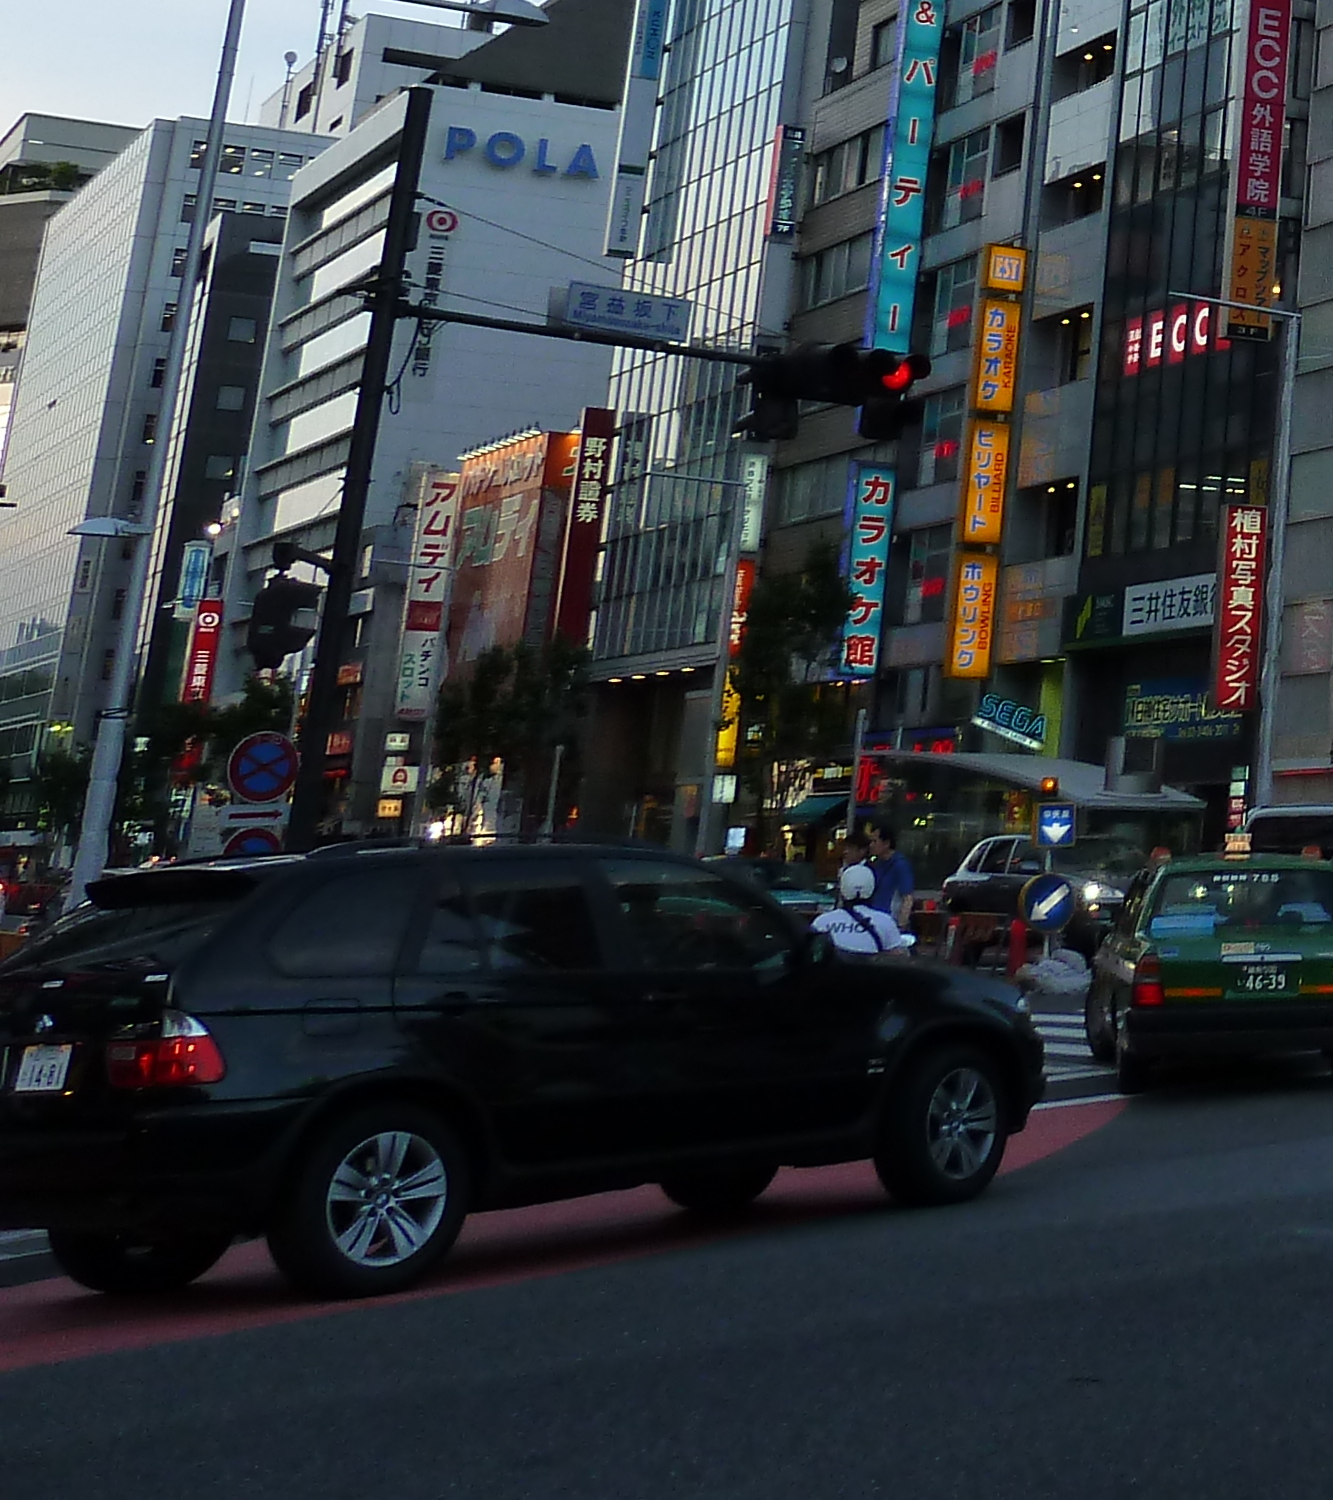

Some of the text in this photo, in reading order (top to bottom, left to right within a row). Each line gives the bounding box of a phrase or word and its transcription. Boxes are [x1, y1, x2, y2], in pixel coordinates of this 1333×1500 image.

[444, 126, 599, 179] POLA
[580, 291, 681, 322] 宮益坂下
[1150, 307, 1210, 360] ECC
[980, 307, 1008, 403] カラオケ
[1002, 325, 1016, 389] KARAOKE
[576, 437, 607, 524] 野村證券
[989, 451, 1004, 514] BILLIARD
[845, 475, 891, 668] カラオケ館
[957, 562, 983, 669] ボウリング
[977, 582, 993, 651] BOWLING
[1223, 508, 1264, 707] 植村写真スタジオ
[977, 692, 1047, 742] SEGA
